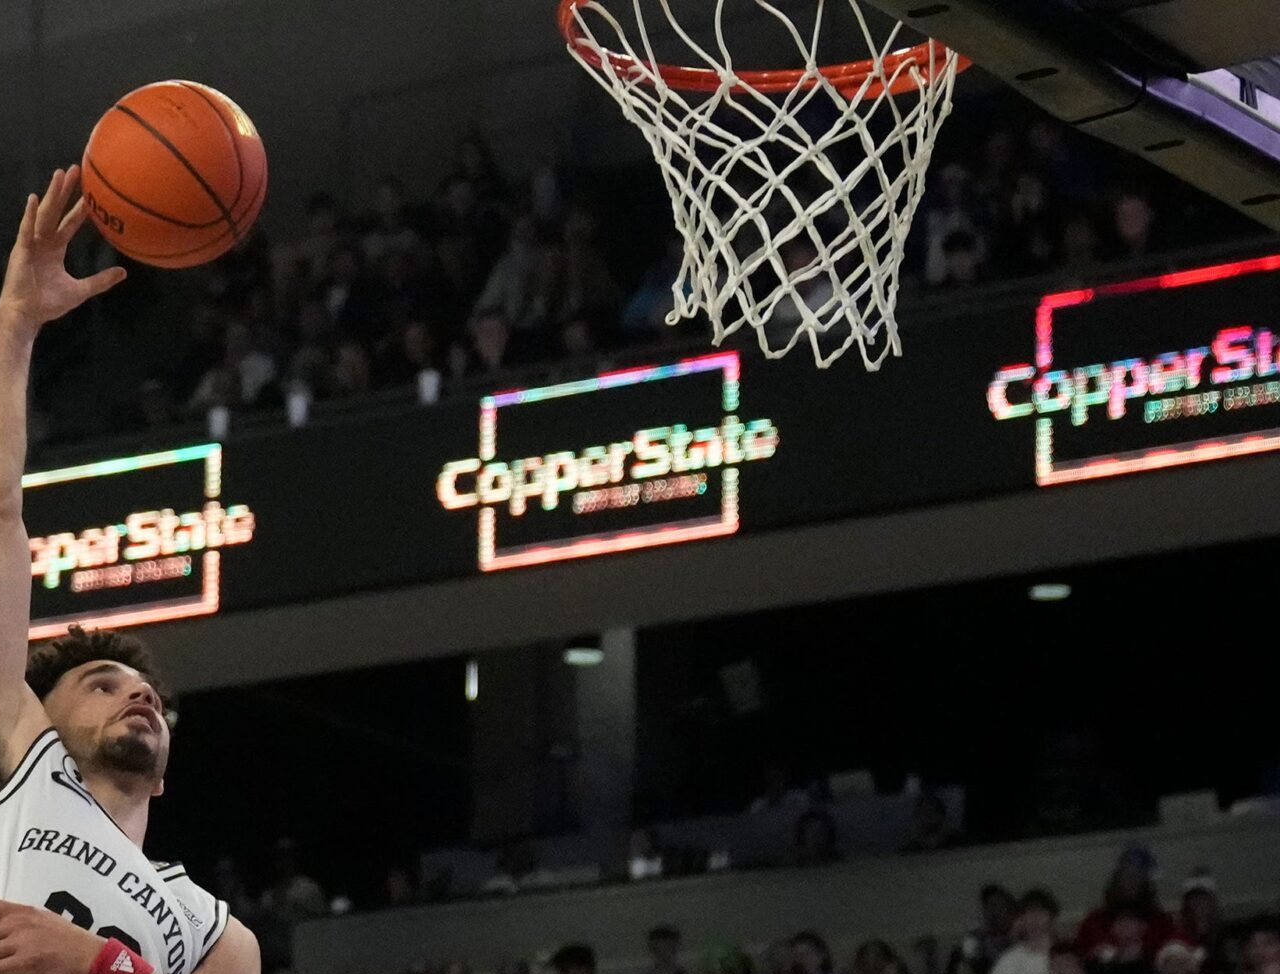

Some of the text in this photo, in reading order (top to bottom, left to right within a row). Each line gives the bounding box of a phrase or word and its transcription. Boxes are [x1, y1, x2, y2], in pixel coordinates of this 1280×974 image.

[986, 325, 1280, 426] CopperSt
[436, 414, 780, 516] CopperState
[18, 827, 117, 877] GRAND
